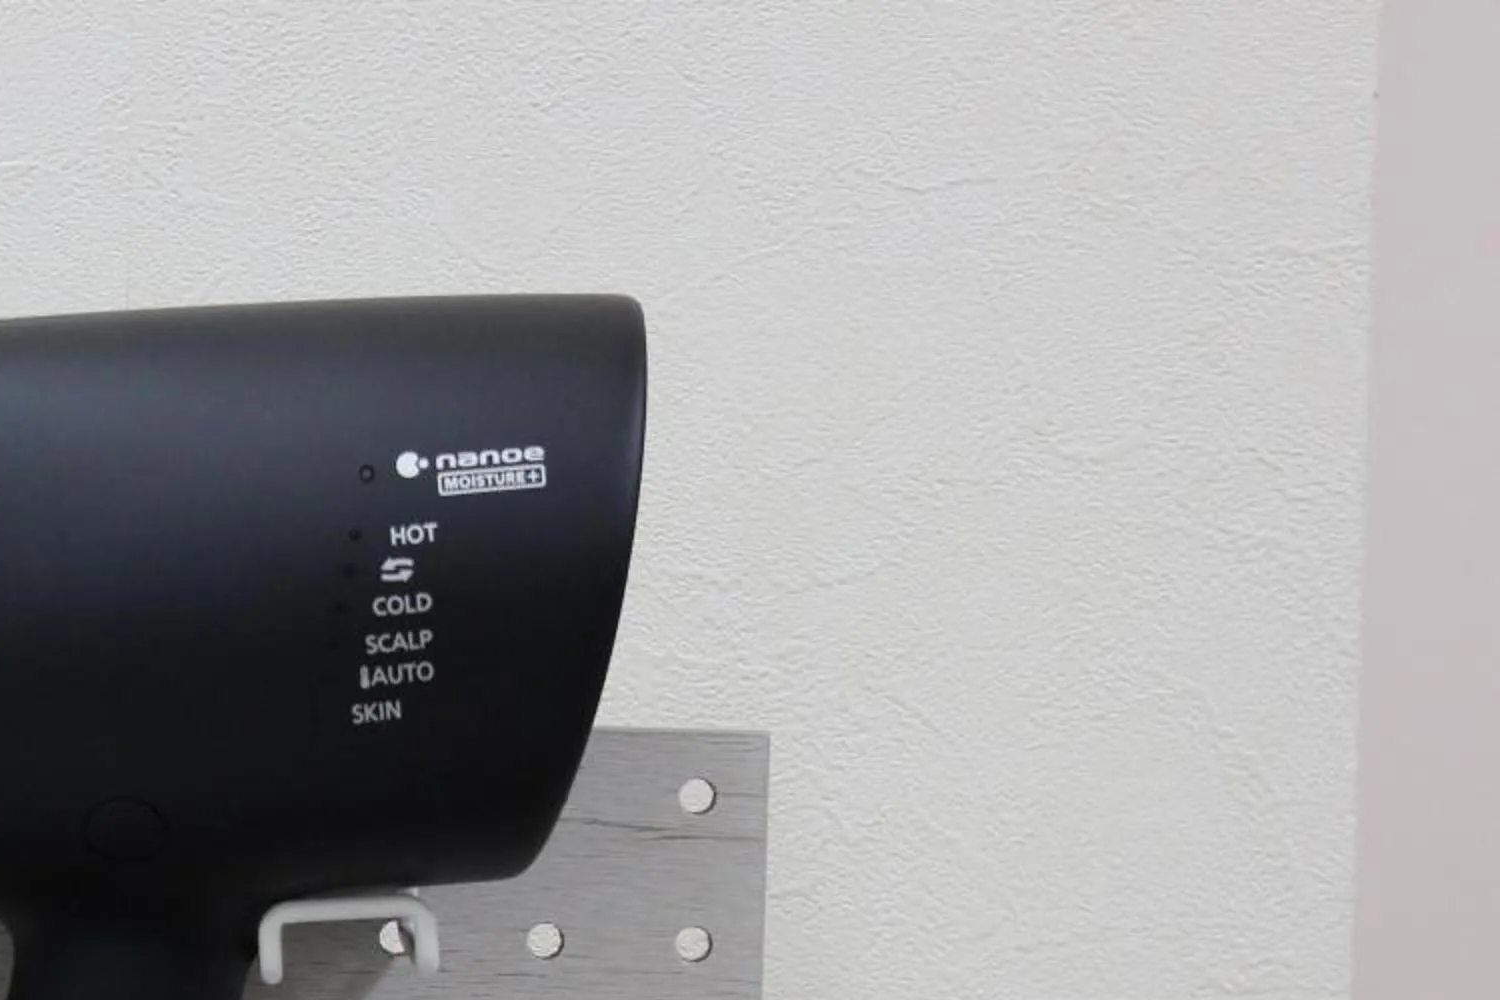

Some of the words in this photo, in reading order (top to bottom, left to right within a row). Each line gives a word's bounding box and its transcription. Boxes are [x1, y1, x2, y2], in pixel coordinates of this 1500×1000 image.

[435, 446, 546, 470] nanoe
[390, 522, 439, 546] HOT
[372, 593, 433, 617] COLD
[365, 629, 434, 655] SCALP
[371, 661, 435, 686] AUTO
[351, 701, 402, 725] SKIN
